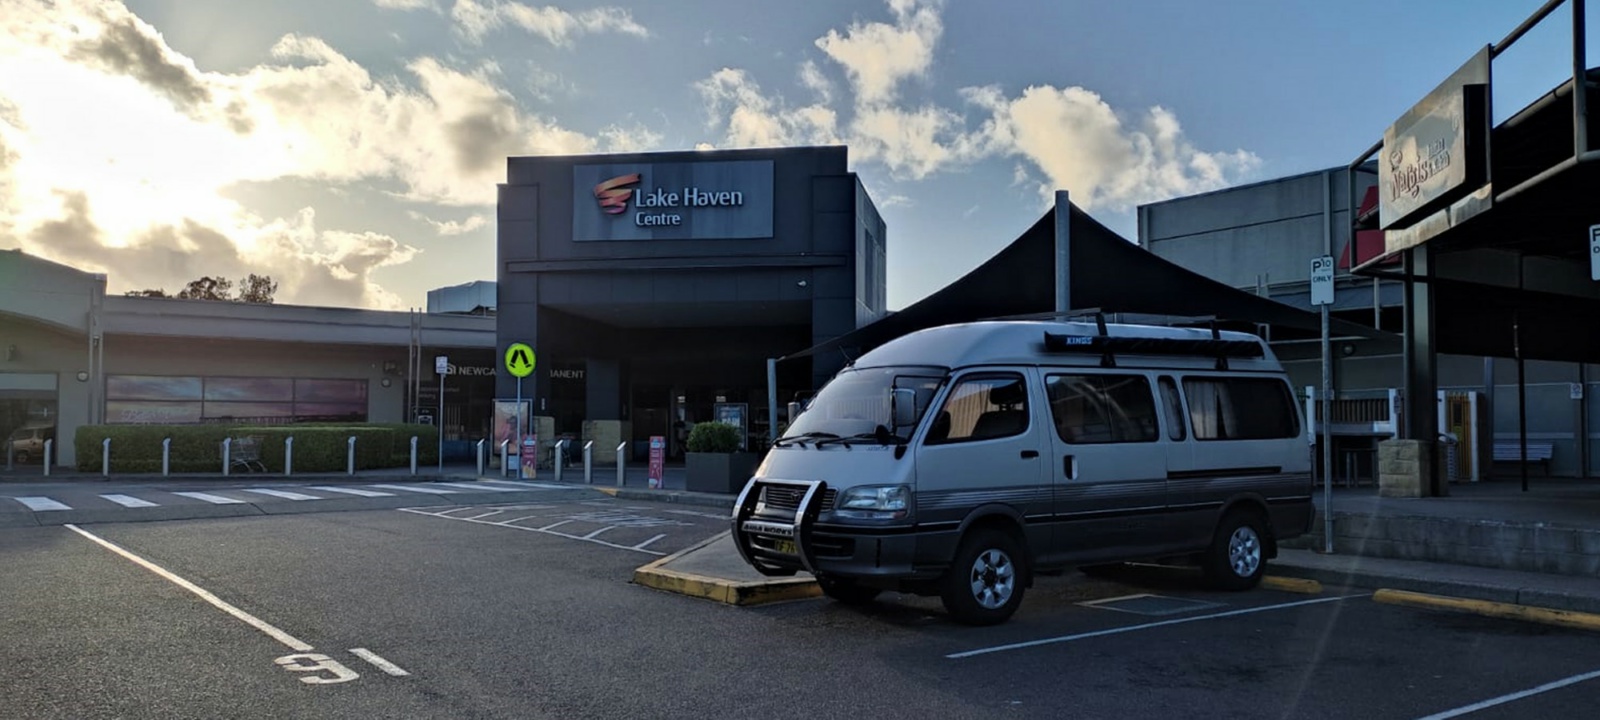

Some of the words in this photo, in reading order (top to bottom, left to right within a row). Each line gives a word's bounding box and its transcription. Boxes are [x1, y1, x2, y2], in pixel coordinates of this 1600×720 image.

[636, 188, 679, 208] Lake
[684, 187, 743, 206] Haven
[636, 211, 681, 226] Centre
[1313, 274, 1332, 283] ONLY
[1066, 336, 1093, 345] KINGS
[458, 366, 496, 376] NEWCA
